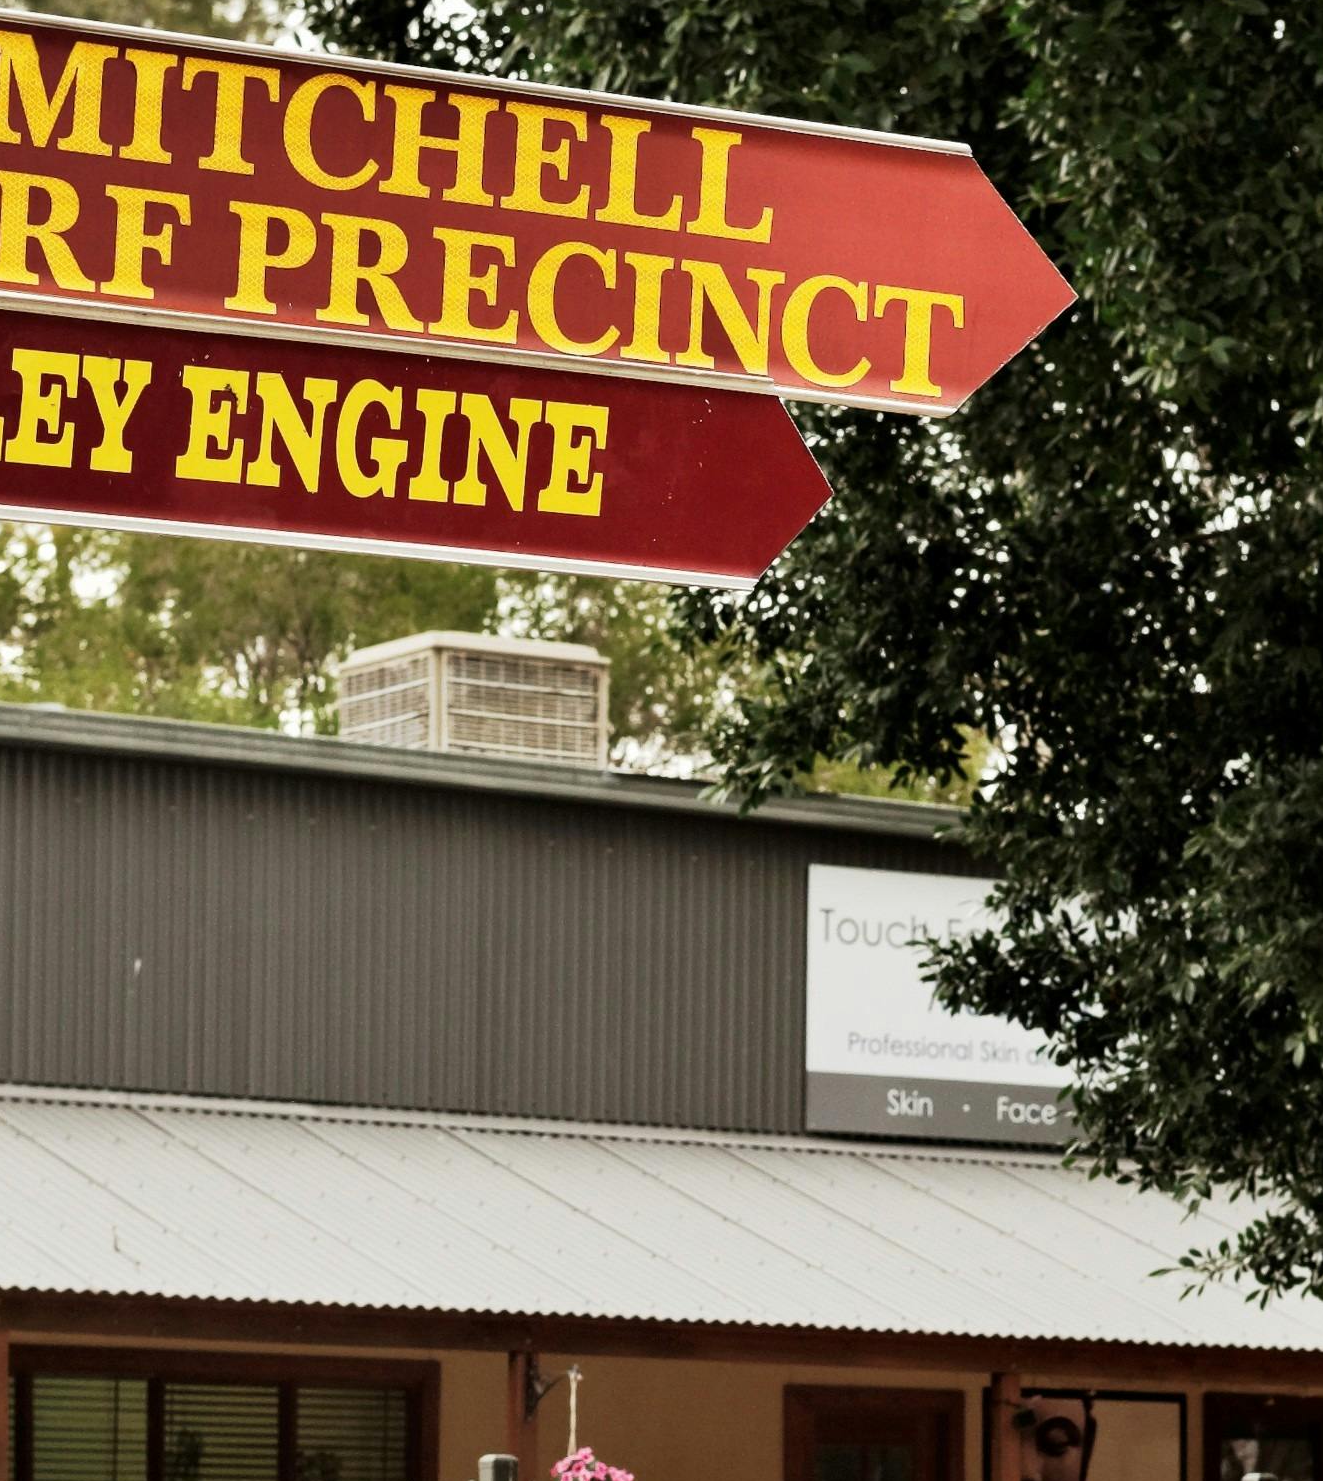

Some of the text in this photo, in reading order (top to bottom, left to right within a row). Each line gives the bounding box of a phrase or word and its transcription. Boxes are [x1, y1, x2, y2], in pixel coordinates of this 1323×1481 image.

[224, 200, 965, 398] PRECINCT
[177, 366, 609, 517] ENGINE
[819, 908, 929, 949] Touch
[847, 1031, 974, 1061] Professional
[980, 1040, 1020, 1063] Skin
[886, 1088, 1058, 1125] Skin Face
